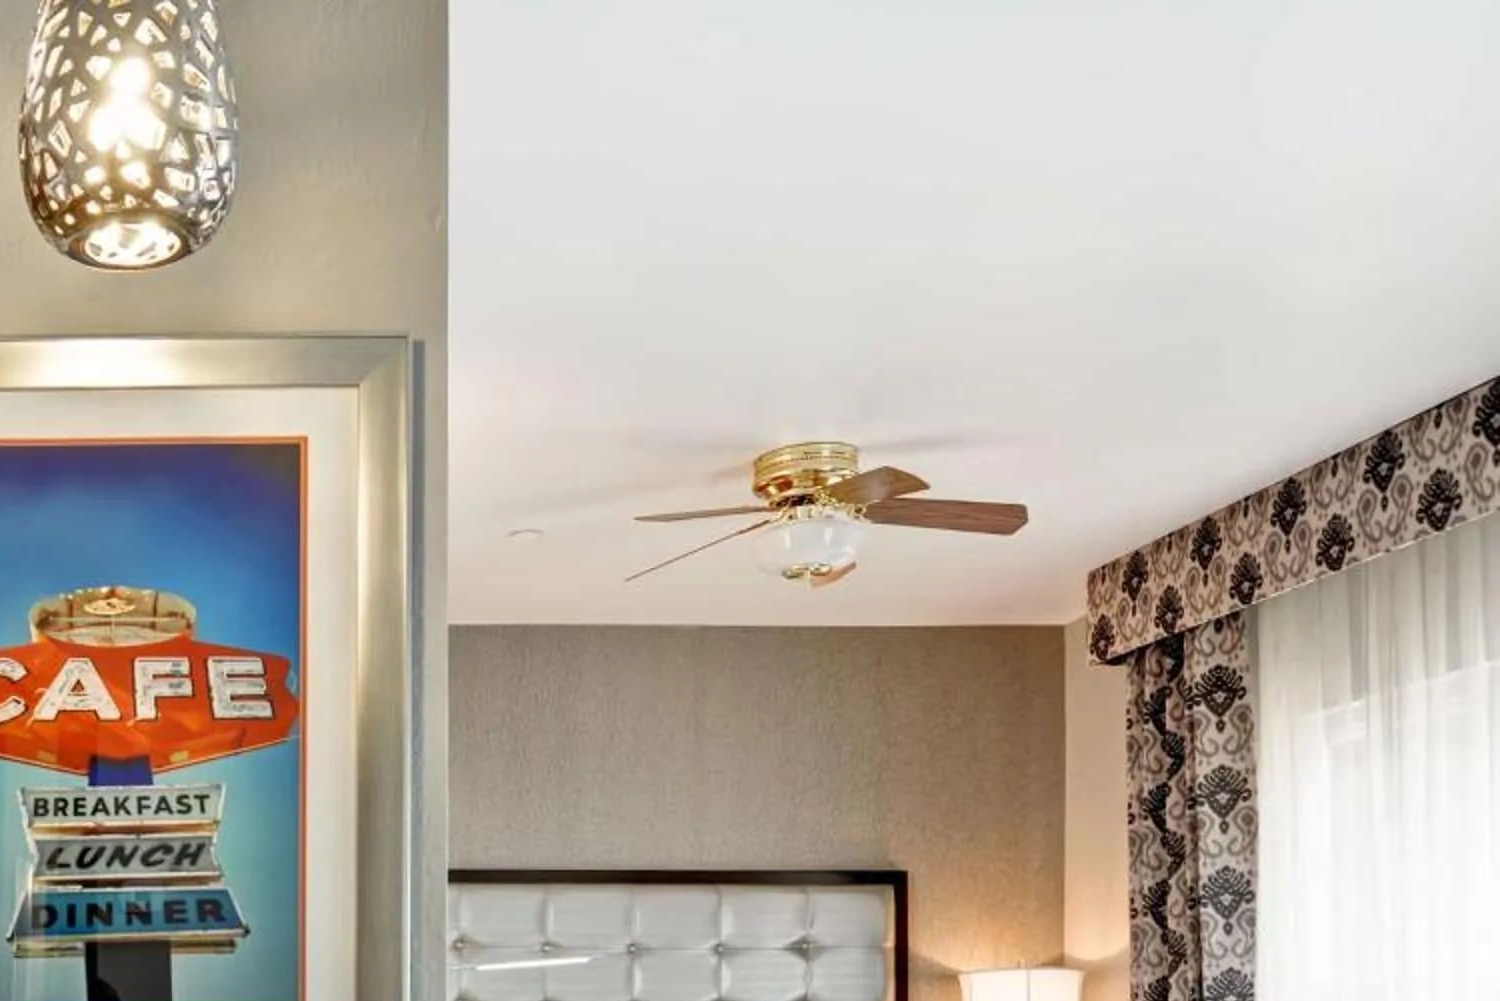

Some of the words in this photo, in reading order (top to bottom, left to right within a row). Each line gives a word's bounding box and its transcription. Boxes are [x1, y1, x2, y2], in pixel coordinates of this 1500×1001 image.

[33, 794, 210, 817] BREAKFAST
[45, 842, 206, 871] LUNCH
[31, 898, 228, 930] DINNER
